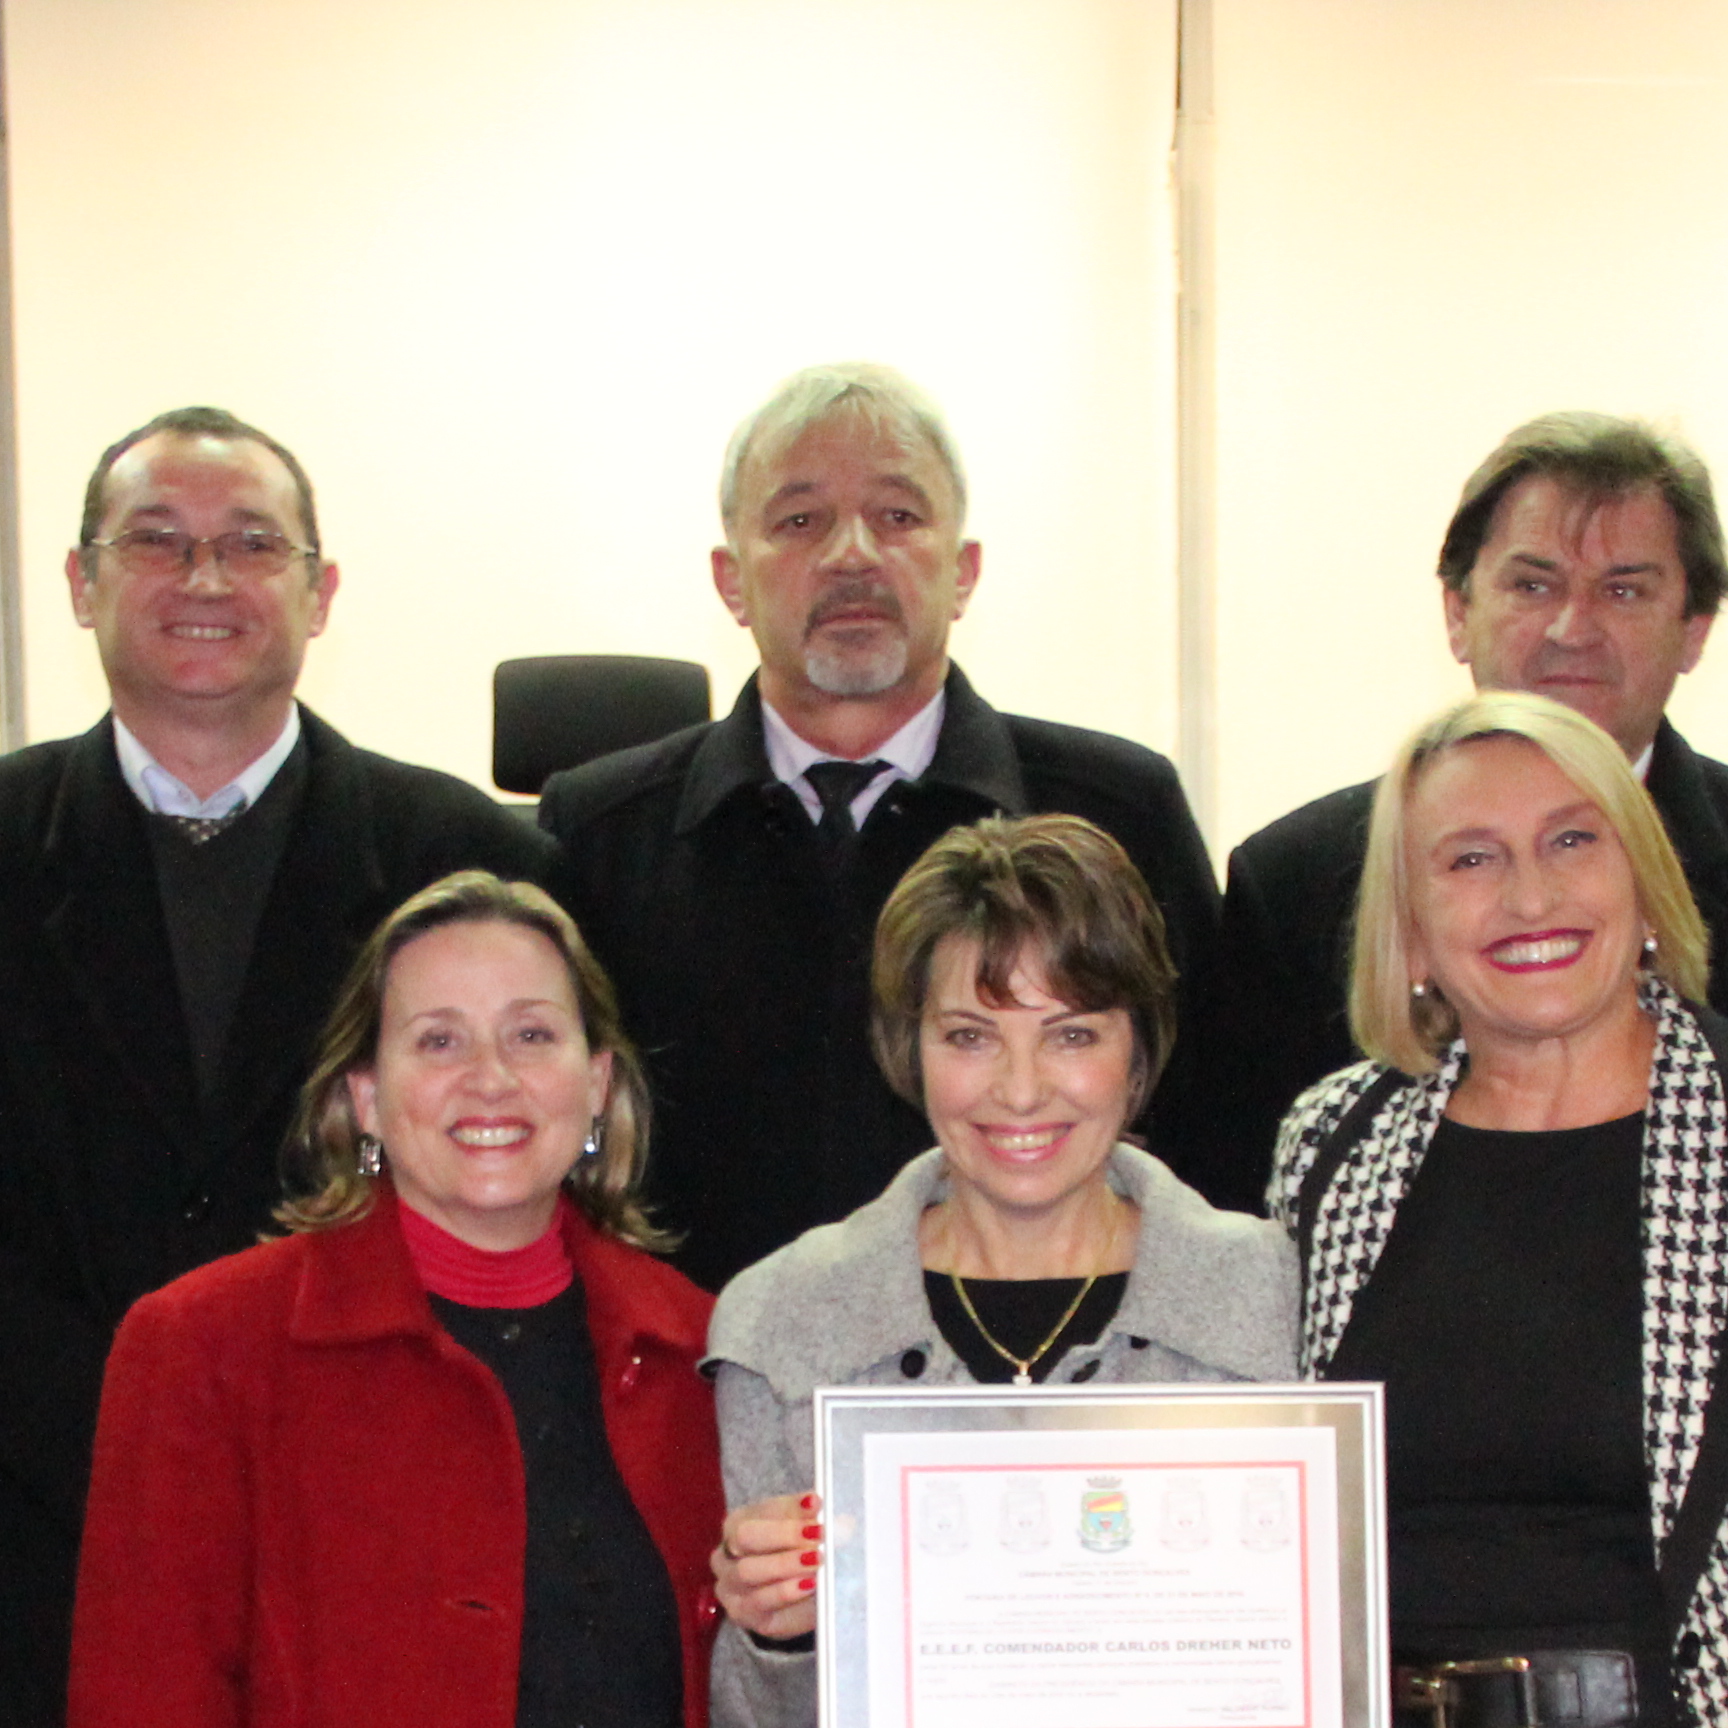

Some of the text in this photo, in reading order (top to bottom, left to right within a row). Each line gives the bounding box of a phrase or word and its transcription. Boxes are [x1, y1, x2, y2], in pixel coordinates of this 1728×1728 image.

[920, 1637, 1292, 1656] E.E.E.F. COMENDADOR CARLOS DREHER NETO
